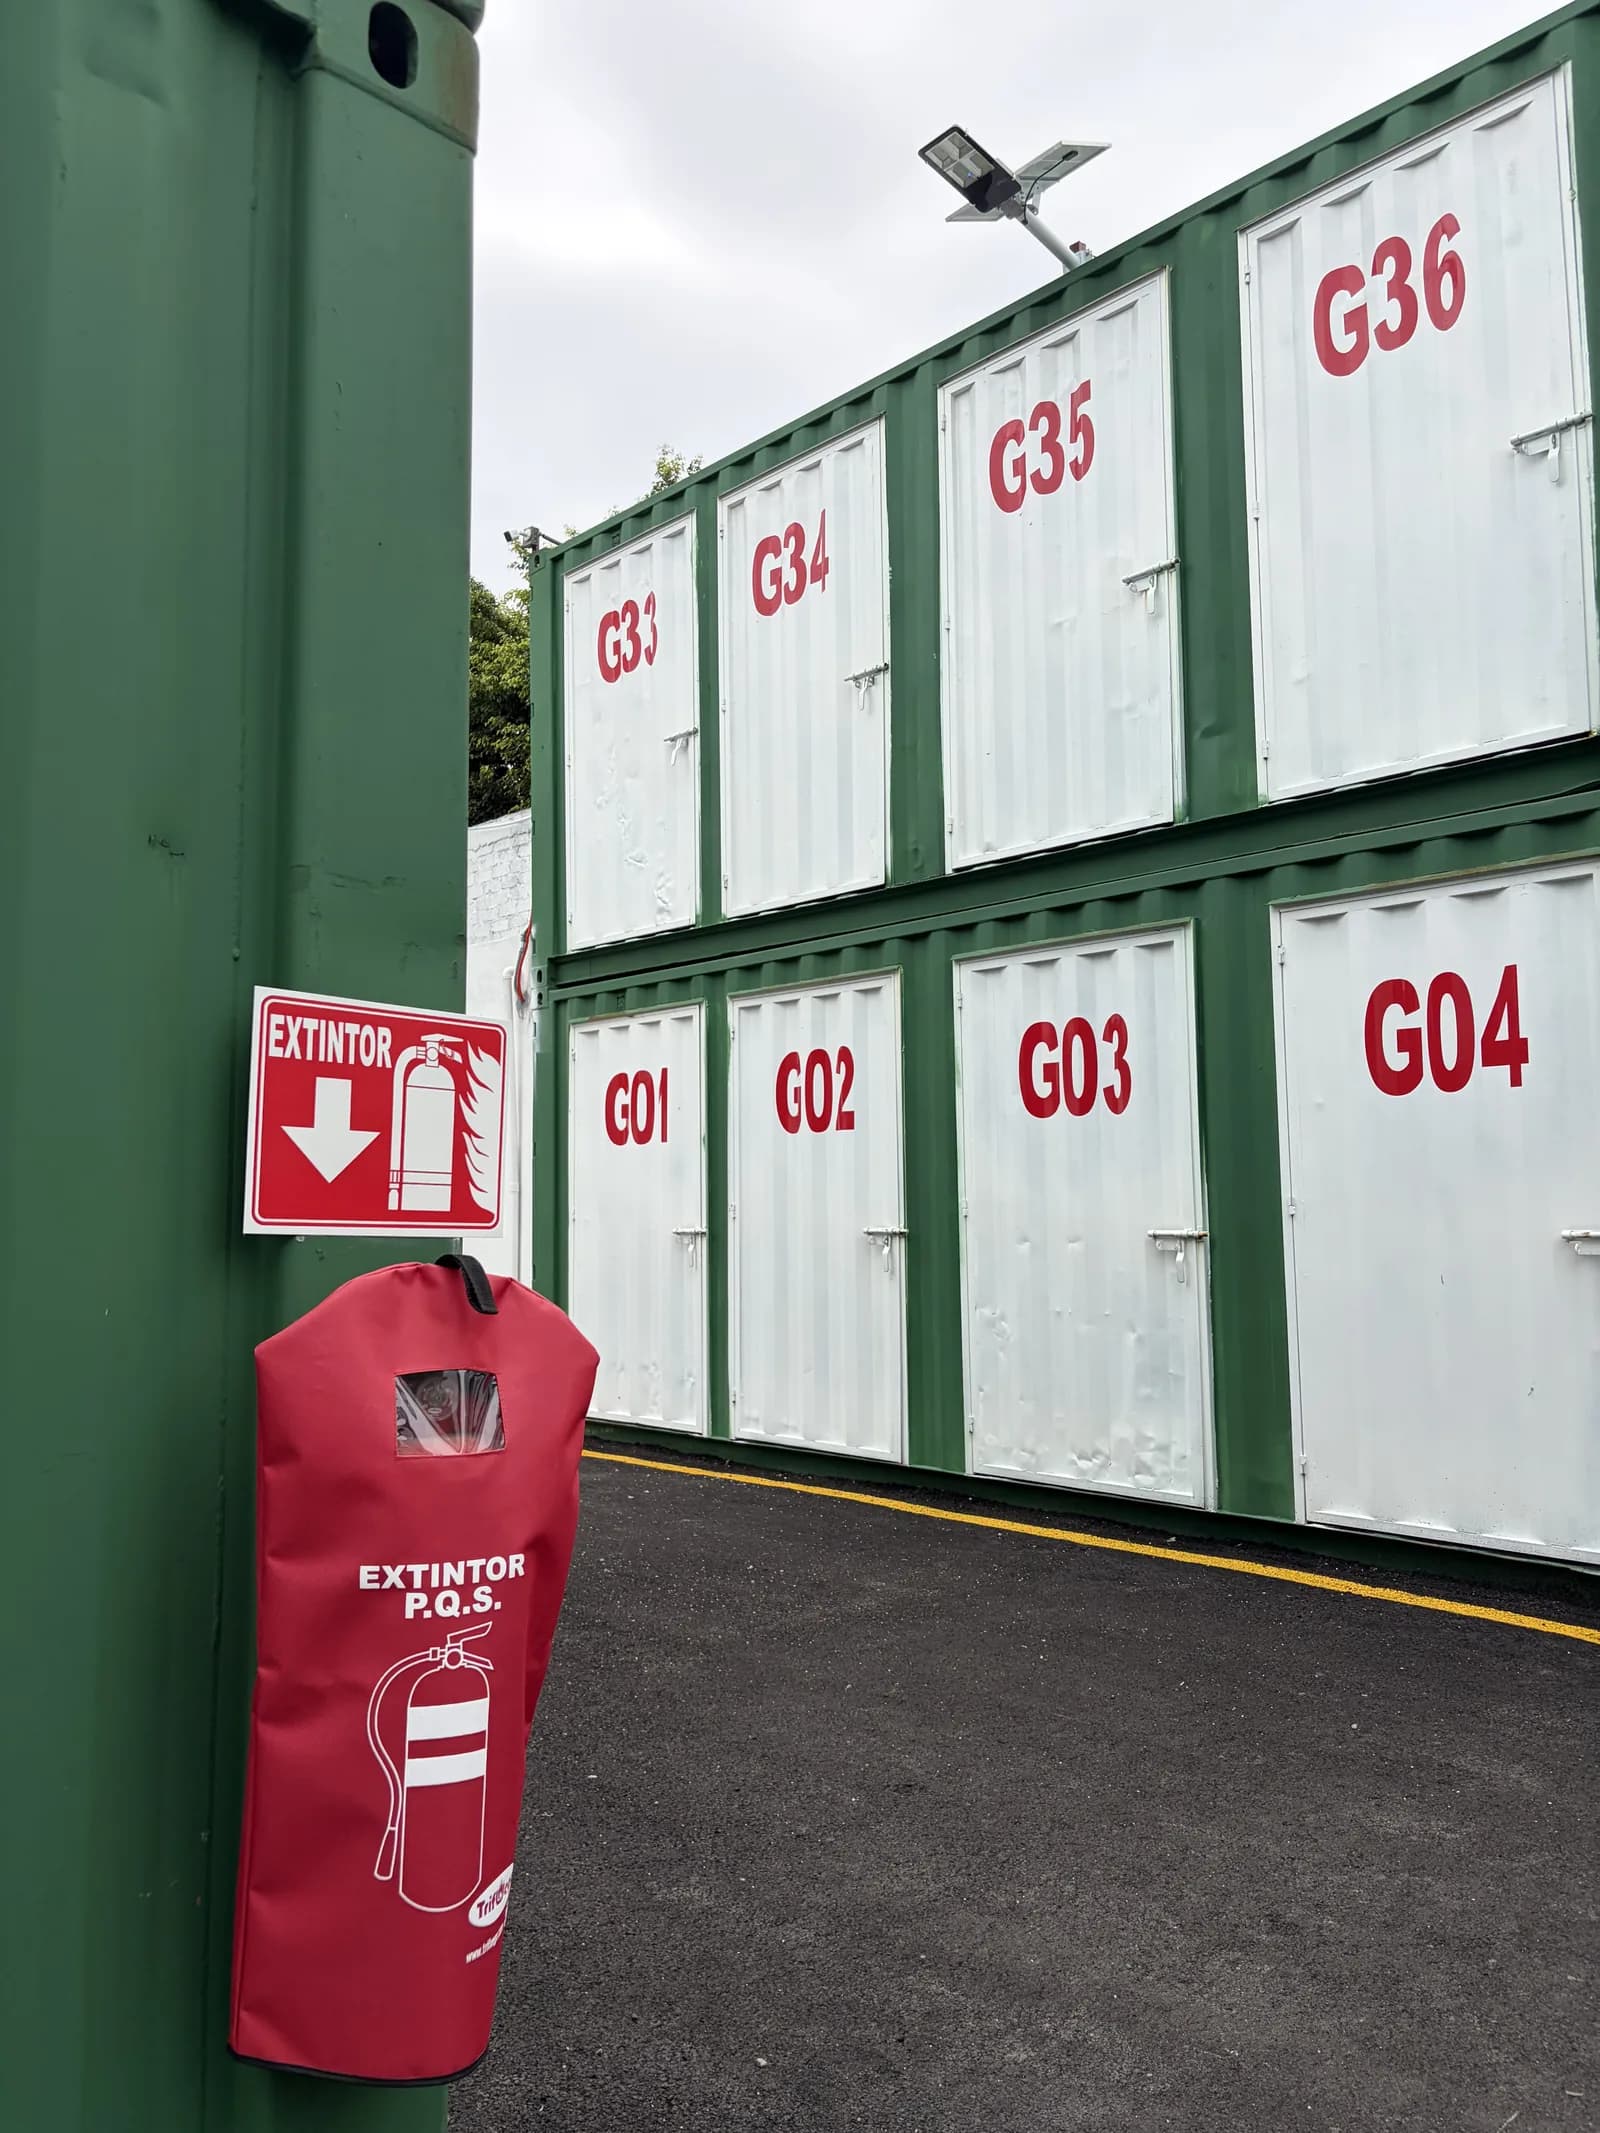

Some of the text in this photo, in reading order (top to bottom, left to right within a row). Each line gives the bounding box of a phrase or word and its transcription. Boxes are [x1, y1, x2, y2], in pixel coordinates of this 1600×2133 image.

[1313, 213, 1466, 377] G36
[988, 380, 1096, 514] G35
[751, 510, 830, 617] G34
[597, 591, 658, 684] G33
[268, 1013, 393, 1069] EXTINTOR
[1018, 1013, 1132, 1119] G03
[1363, 964, 1529, 1097] G04
[604, 1067, 669, 1147] G01
[775, 1046, 855, 1135] G02
[359, 1553, 525, 1590] EXTINTOR
[404, 1585, 502, 1619] P.Q.S.
